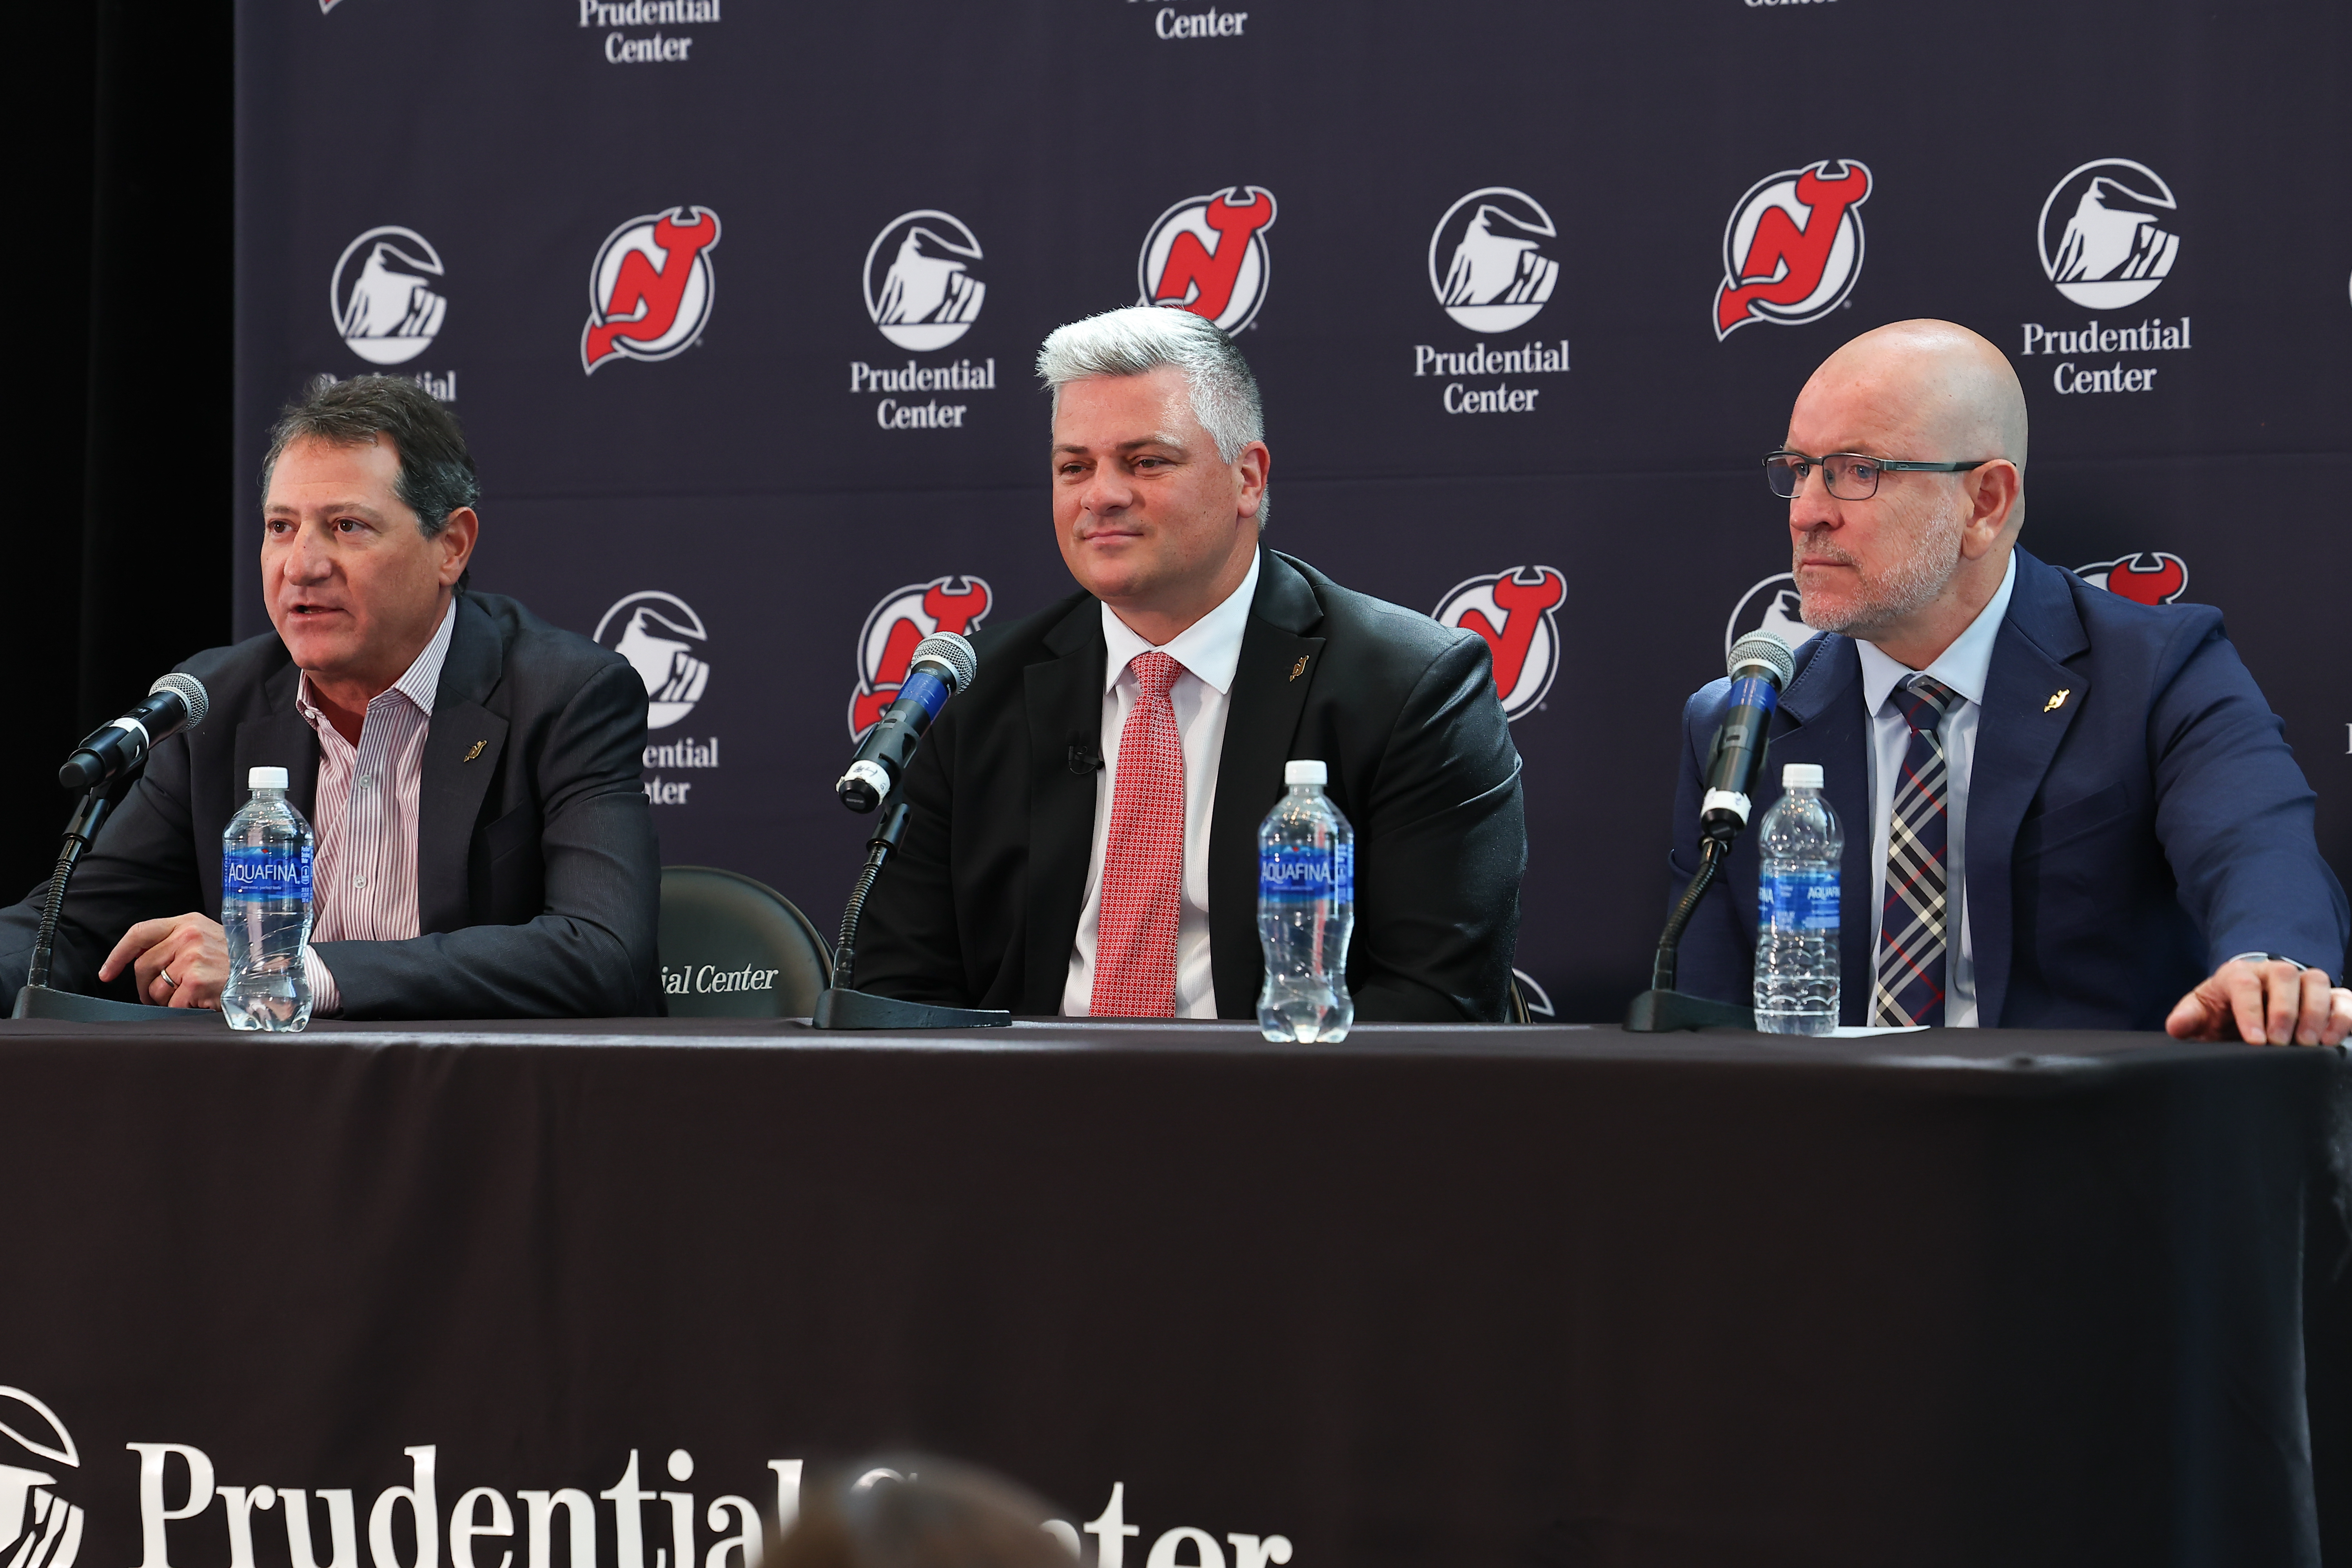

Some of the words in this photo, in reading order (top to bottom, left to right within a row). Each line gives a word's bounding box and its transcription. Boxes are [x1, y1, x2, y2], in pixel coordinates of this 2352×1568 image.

[579, 0, 720, 27] Prudential
[1155, 7, 1248, 40] Center
[604, 31, 693, 64] Center
[2021, 316, 2191, 356] Prudential
[1414, 339, 1570, 377] Prudential
[850, 357, 995, 393] Prudential
[2053, 361, 2158, 394] Center
[877, 398, 967, 430] Center
[1443, 383, 1539, 414] Center
[642, 736, 719, 768] ential
[228, 863, 298, 884] AQUAFINA
[1261, 861, 1331, 884] AQUAFINA
[695, 962, 779, 994] Center
[126, 1442, 804, 1568] Prudential
